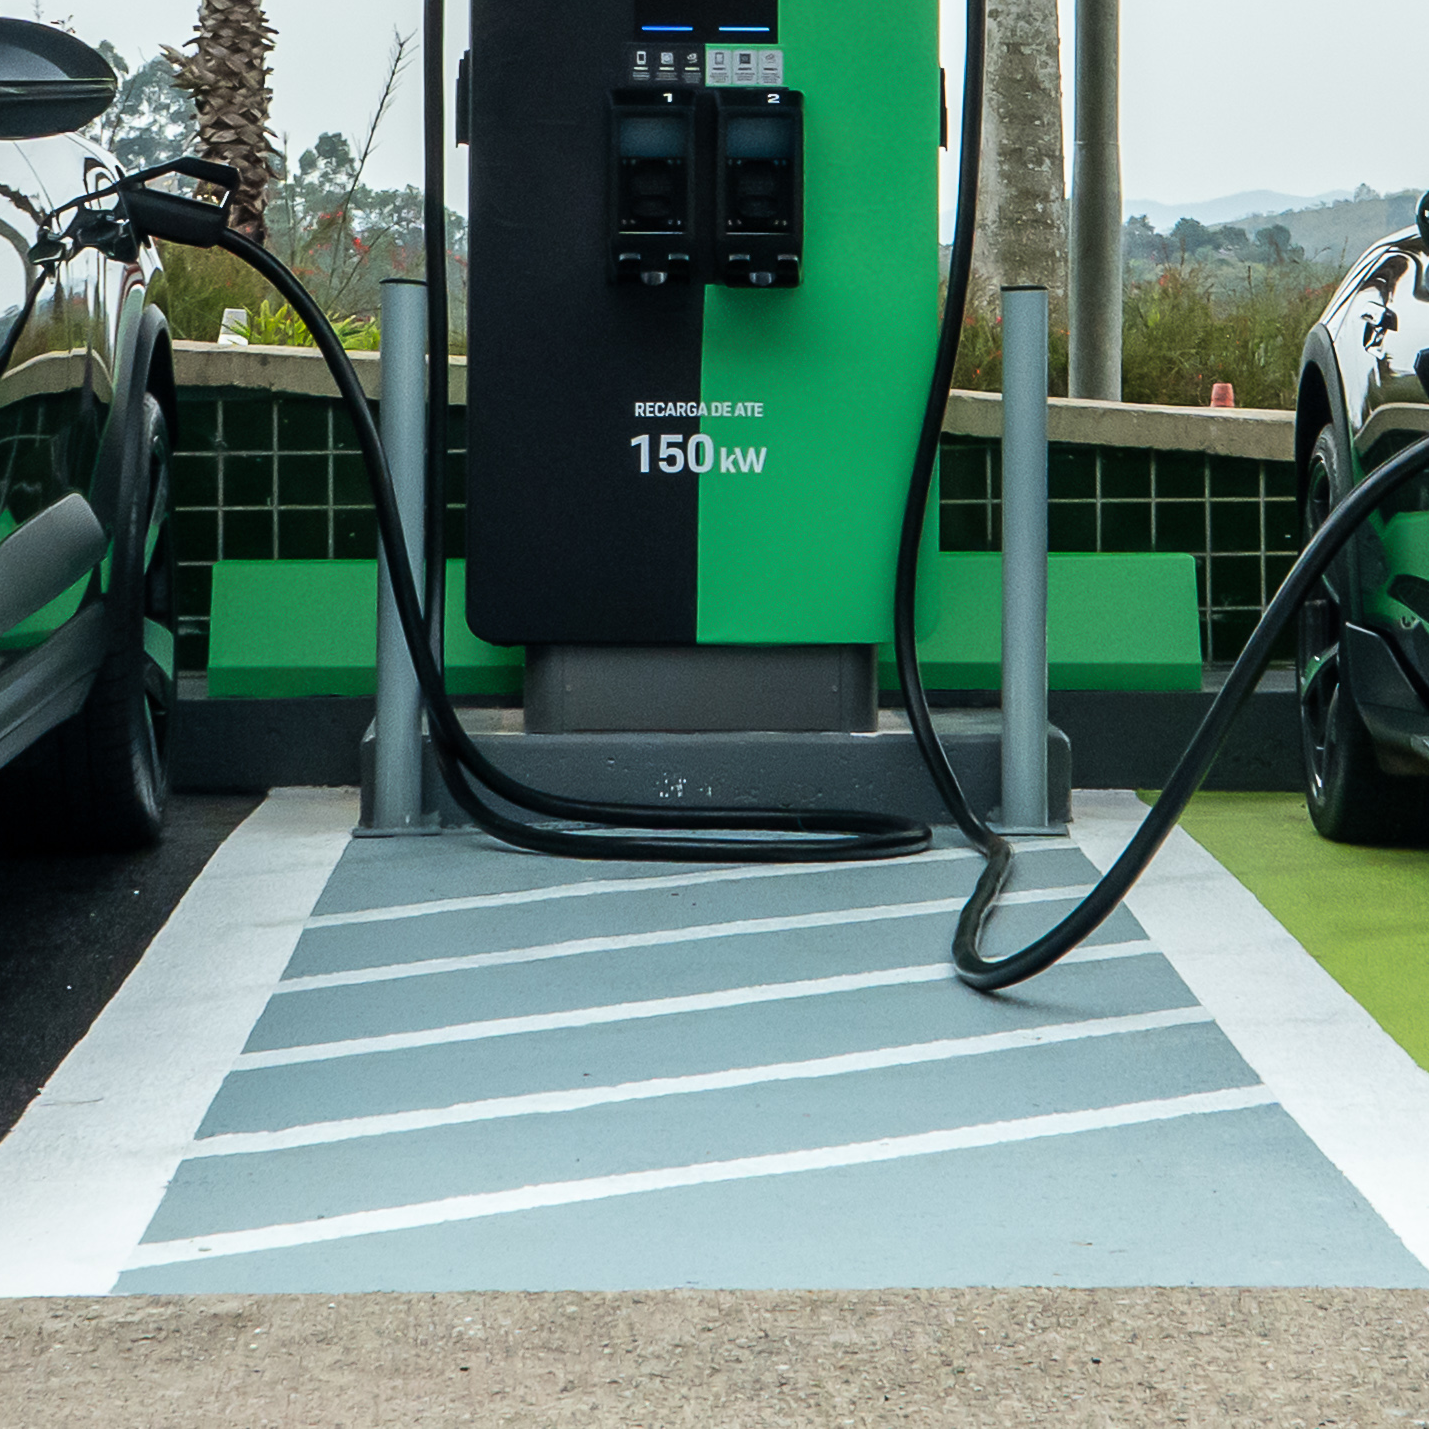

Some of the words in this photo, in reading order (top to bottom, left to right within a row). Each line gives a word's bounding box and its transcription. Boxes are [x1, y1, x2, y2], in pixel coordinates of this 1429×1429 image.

[663, 93, 673, 103] 1
[767, 93, 781, 104] 2
[634, 401, 708, 418] RECARGA
[711, 402, 732, 417] DE
[734, 402, 764, 418] ATE
[630, 433, 715, 474] 150
[720, 447, 767, 474] kW
